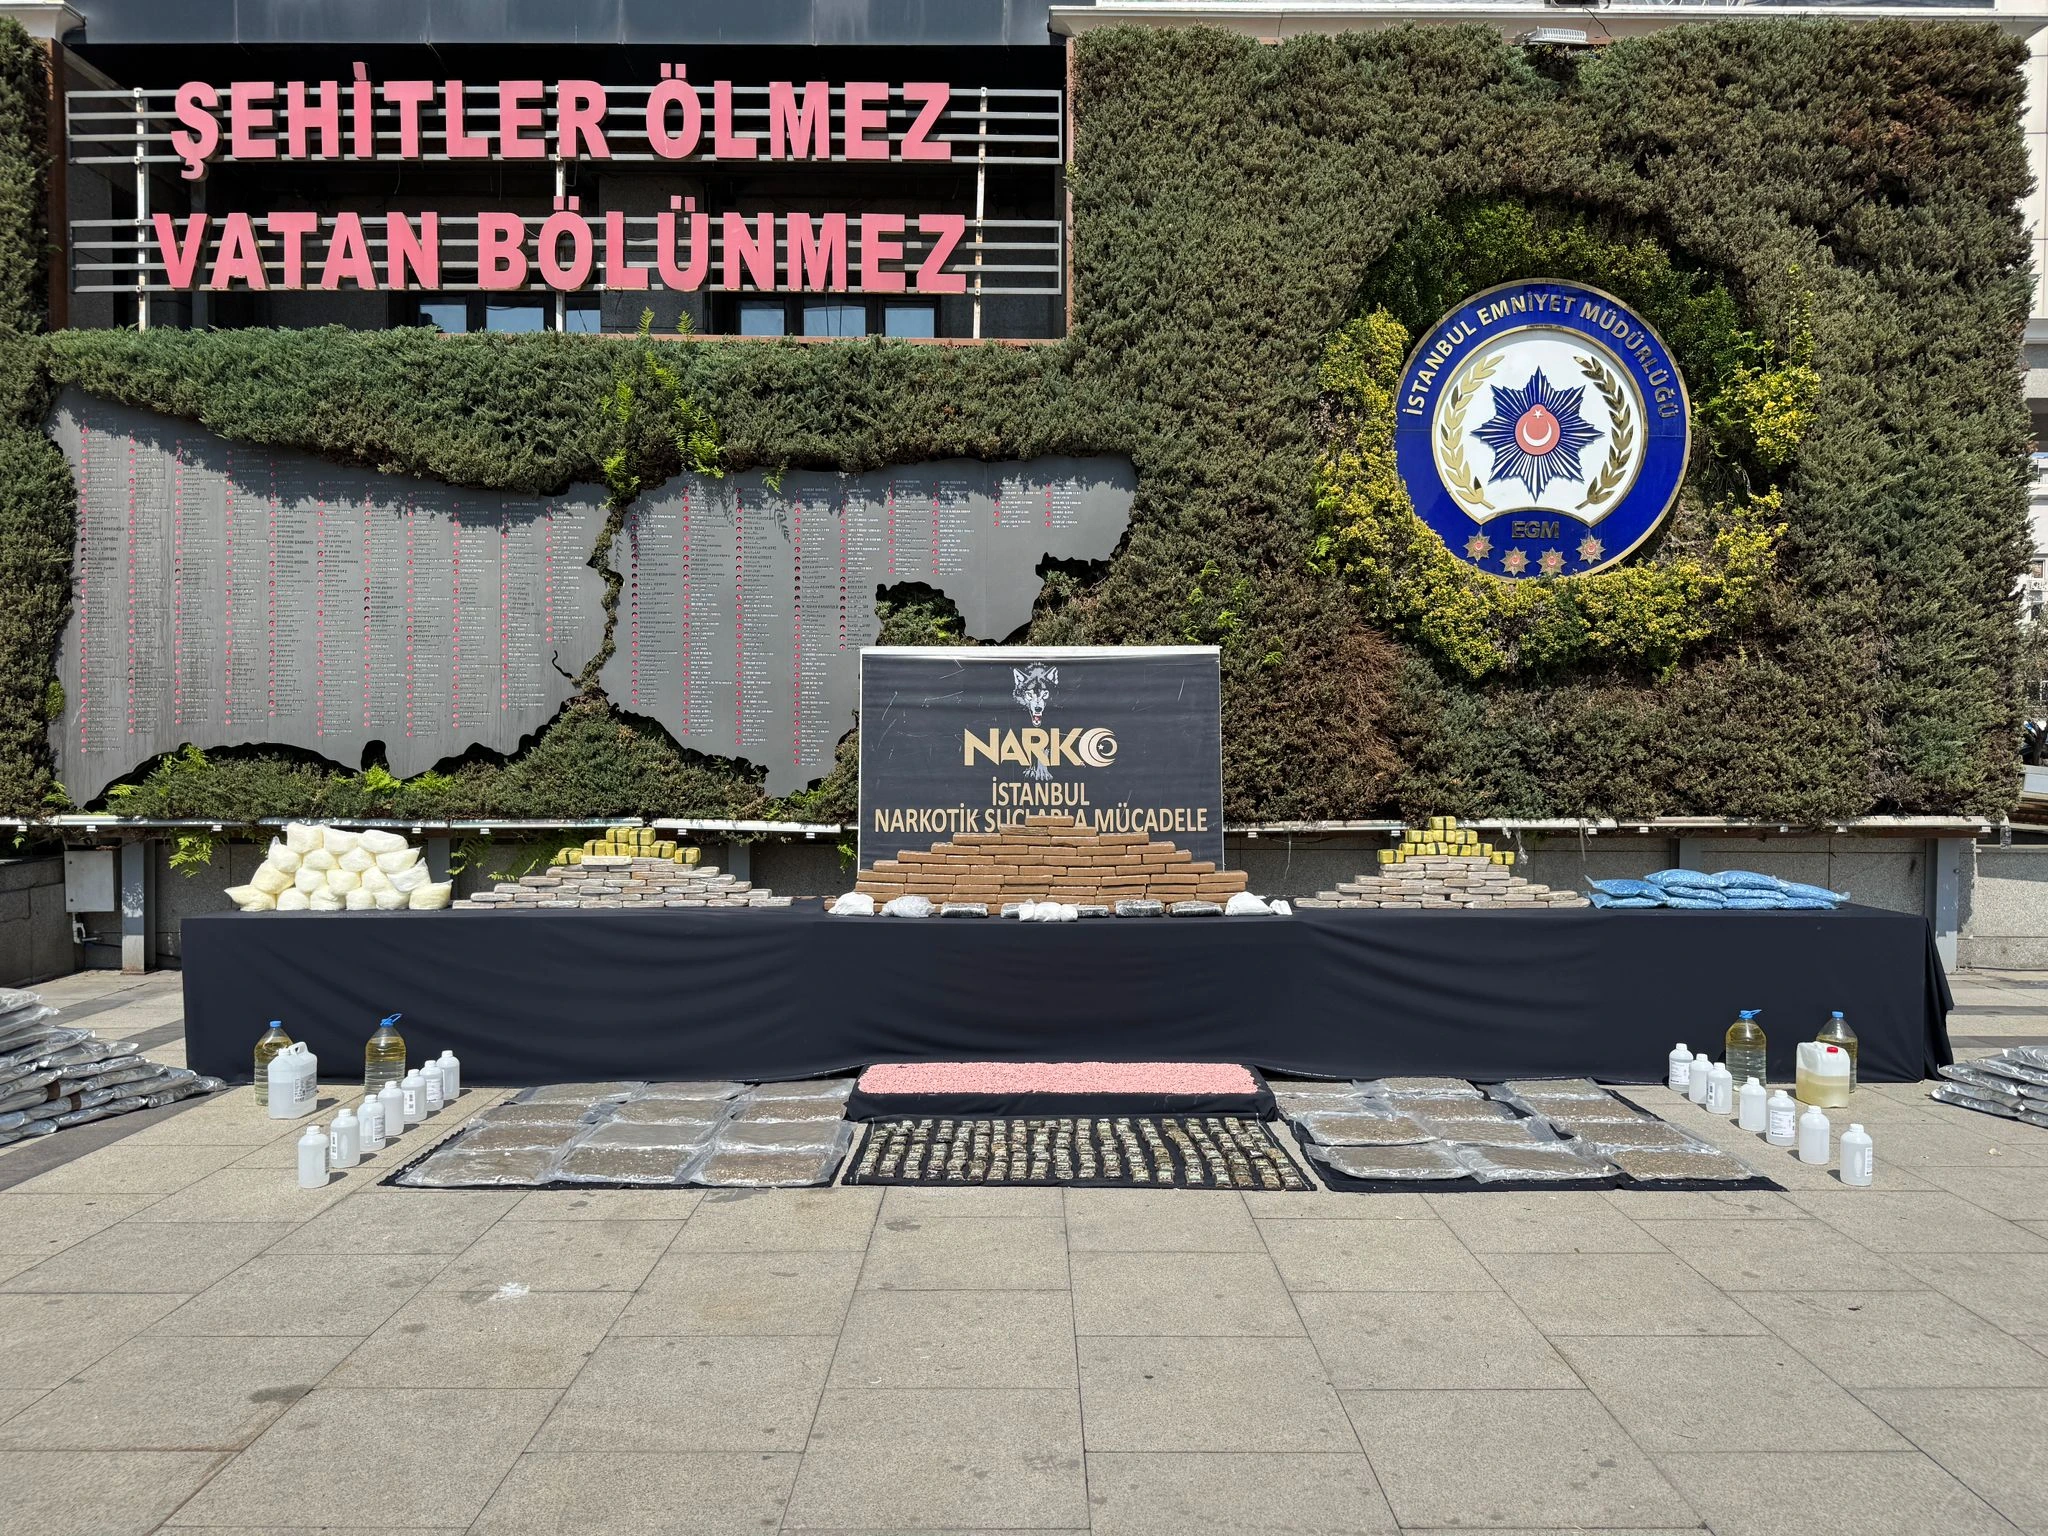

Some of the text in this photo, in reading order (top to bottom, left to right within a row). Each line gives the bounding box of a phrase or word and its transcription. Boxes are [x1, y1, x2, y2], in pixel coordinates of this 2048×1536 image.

[170, 61, 952, 180] ŞEHİTLER ÖLMEZ
[152, 196, 967, 293] VATAN BÖLÜNMEZ
[1402, 291, 1678, 420] İSTANBUL EMNİYET MÜDÜRLÜĞÜ
[1511, 520, 1560, 540] EGM
[964, 728, 1118, 768] NARKO
[992, 776, 1090, 806] İSTANBUL
[875, 803, 979, 833] NARKOTİK
[1095, 803, 1208, 832] MÜCADELE
